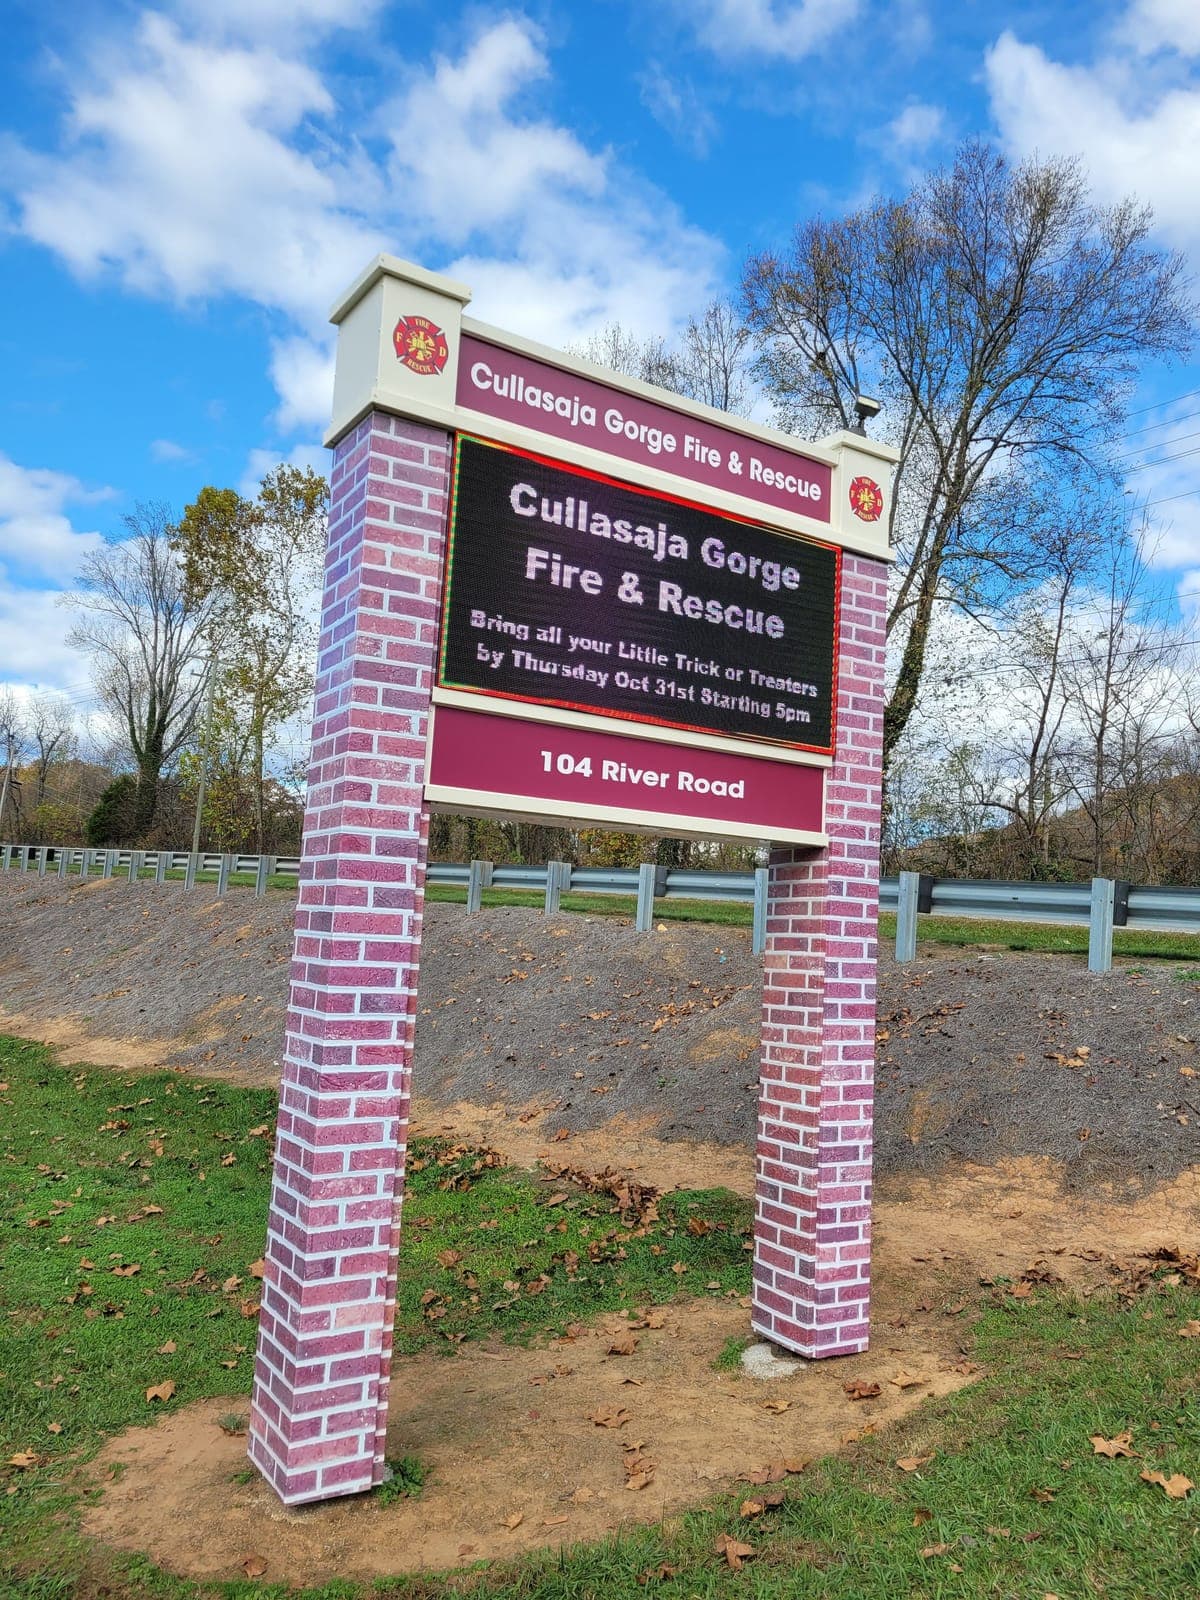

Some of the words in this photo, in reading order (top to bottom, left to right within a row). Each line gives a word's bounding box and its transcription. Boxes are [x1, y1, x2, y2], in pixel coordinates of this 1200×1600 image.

[440, 346, 446, 356] D
[470, 362, 596, 426] Cullasaja
[604, 409, 677, 454] Gorge
[684, 435, 721, 468] Fire
[728, 450, 743, 475] &
[750, 457, 822, 502] Rescue
[510, 483, 688, 561] Cullasaja
[700, 537, 800, 592] Gorge
[525, 547, 603, 595] Fire
[617, 572, 644, 606] &
[658, 580, 785, 639] Rescue
[470, 609, 529, 642] Bring
[536, 625, 561, 645] all
[568, 634, 612, 656] your
[619, 641, 668, 668] Little
[675, 653, 720, 678] Trick
[724, 667, 743, 683] or
[748, 669, 818, 698] Treaters
[476, 643, 504, 669] by
[512, 650, 608, 688] Thursday
[614, 671, 649, 694] Oct
[654, 678, 696, 702] 31st
[700, 688, 771, 718] Starting
[775, 702, 811, 724] 5pm
[540, 750, 592, 778] 104
[602, 760, 670, 789] River
[678, 772, 745, 800] Road
